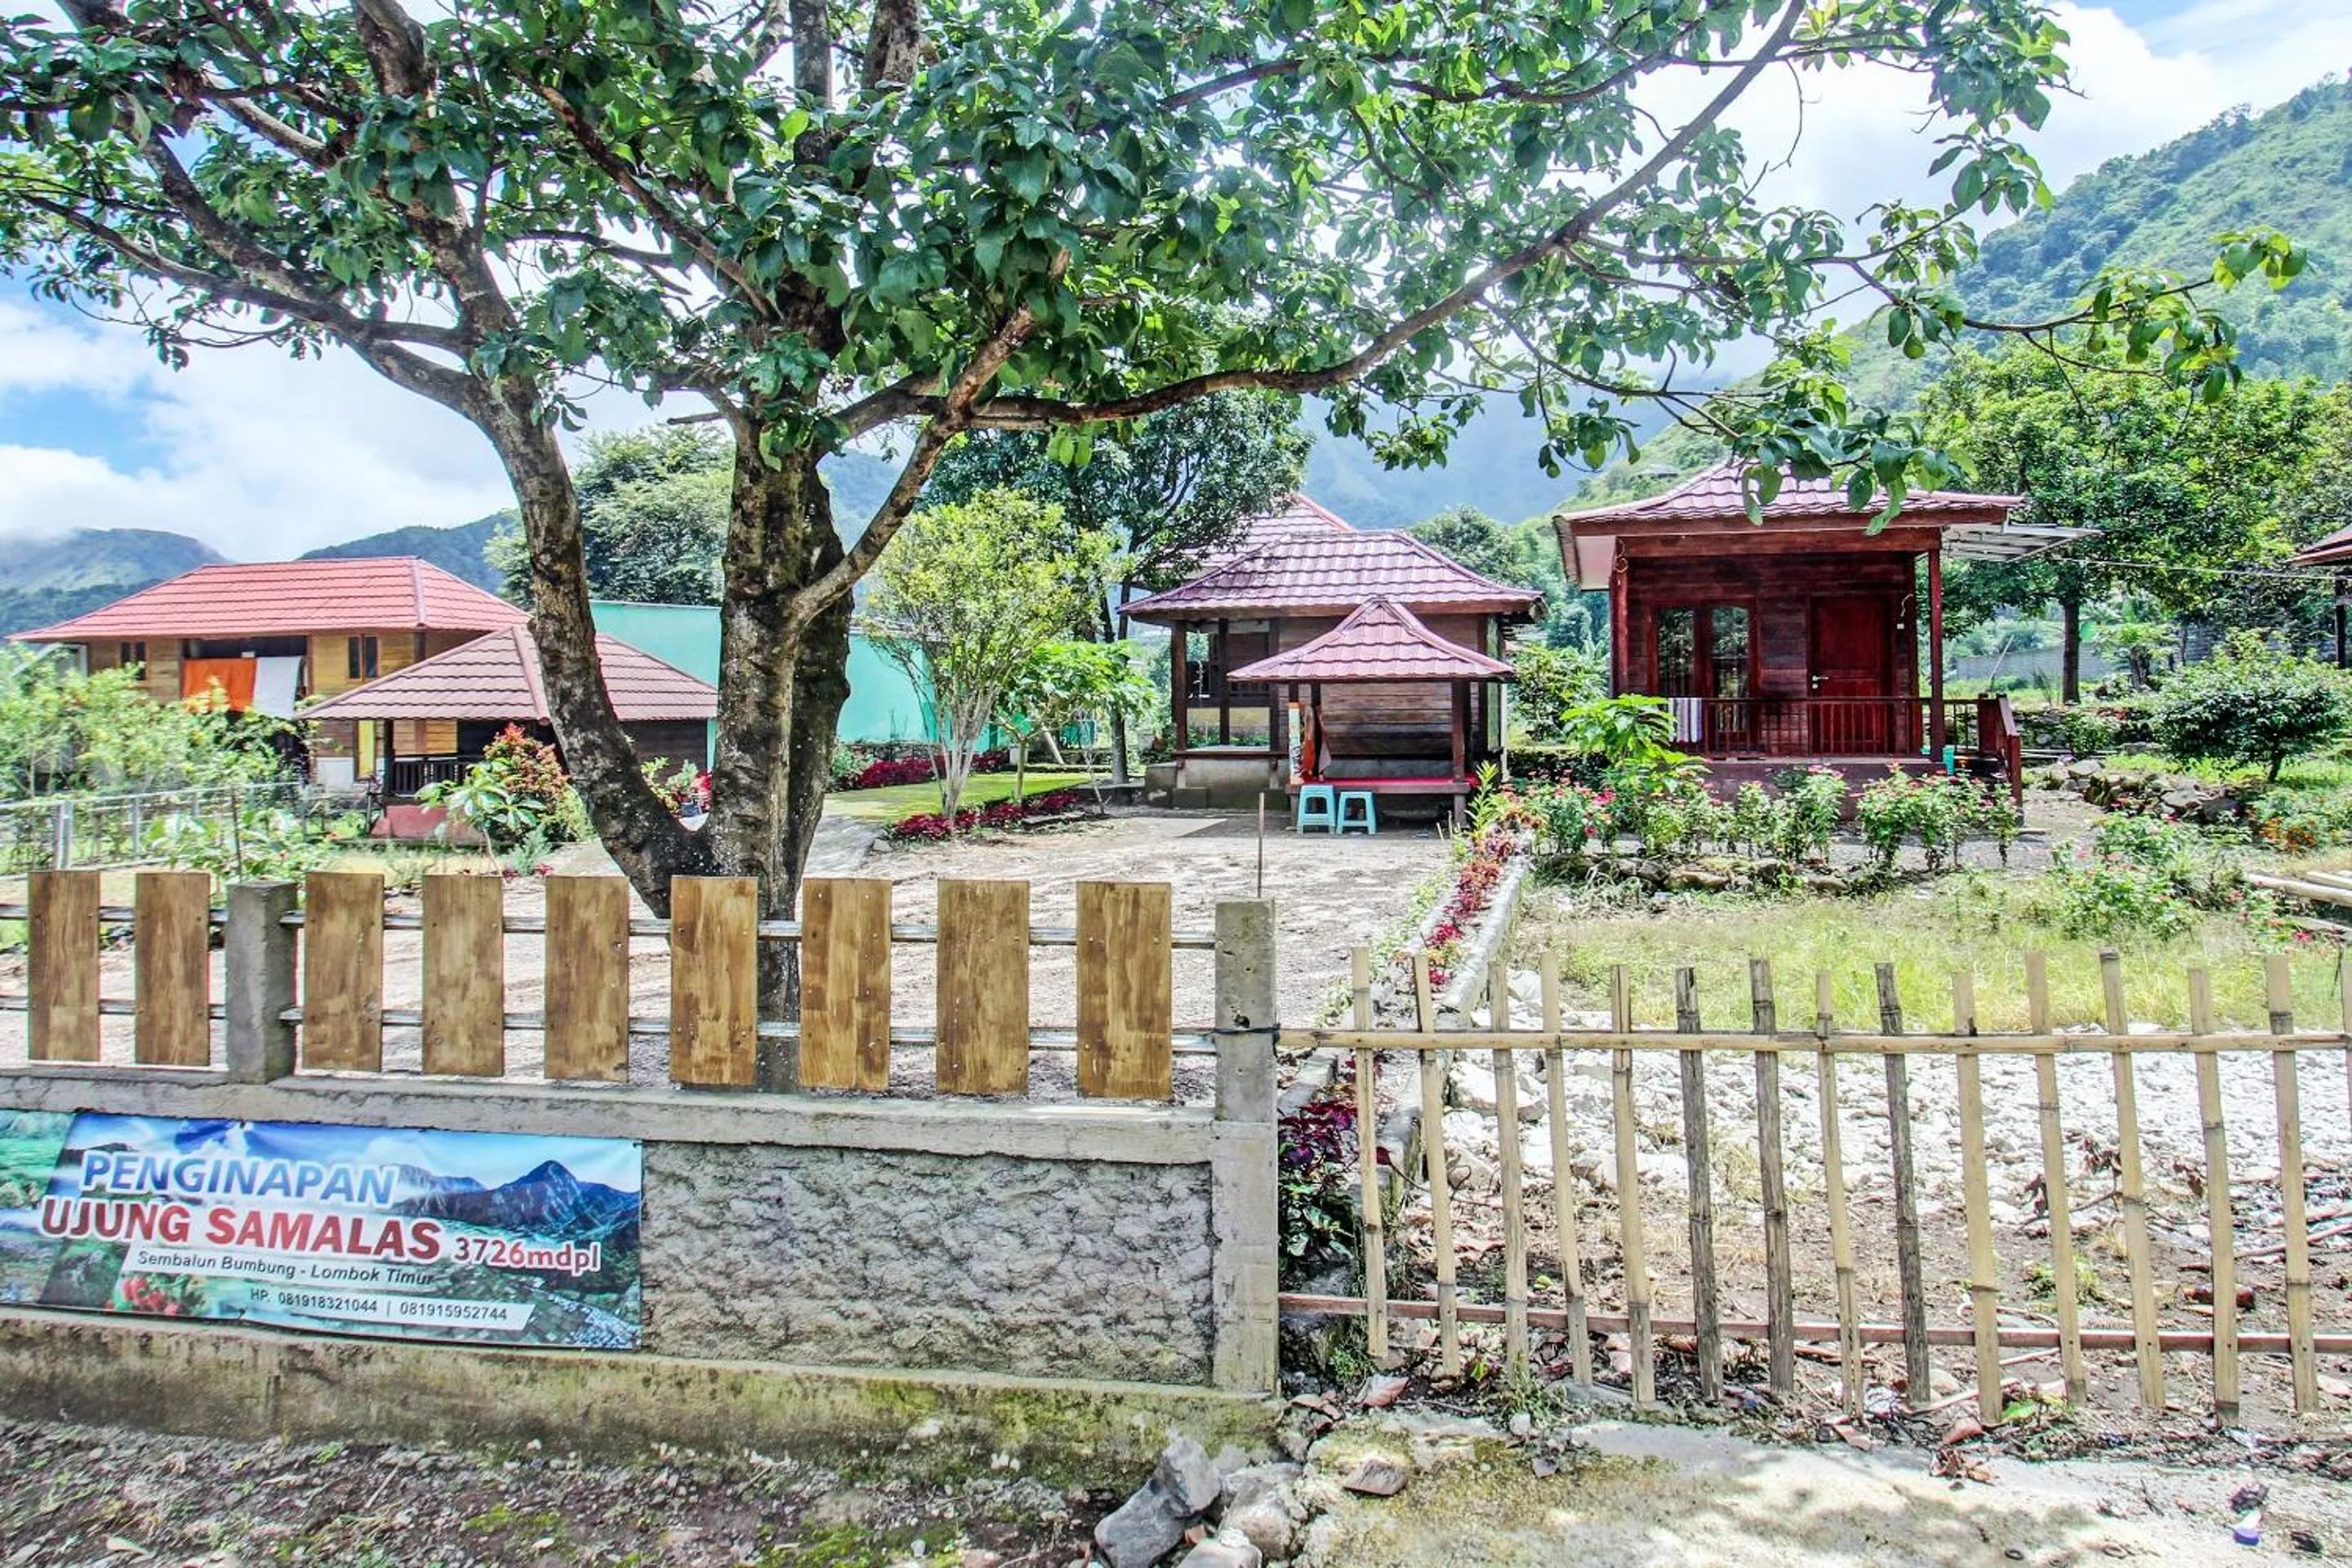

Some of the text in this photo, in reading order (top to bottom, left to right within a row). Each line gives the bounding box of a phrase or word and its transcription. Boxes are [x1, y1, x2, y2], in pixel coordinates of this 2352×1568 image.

[82, 1153, 396, 1205] PENGINAPAN
[42, 1198, 599, 1272] UJUNG SAMALAS 3726mdpl
[138, 1250, 216, 1268] Sembalun
[221, 1255, 296, 1279] Bumbung
[310, 1265, 381, 1282] Lombok
[387, 1267, 434, 1285] Timur
[250, 1288, 271, 1302] HP.
[278, 1292, 378, 1312] 081918321044
[399, 1303, 508, 1321] 081915952744
